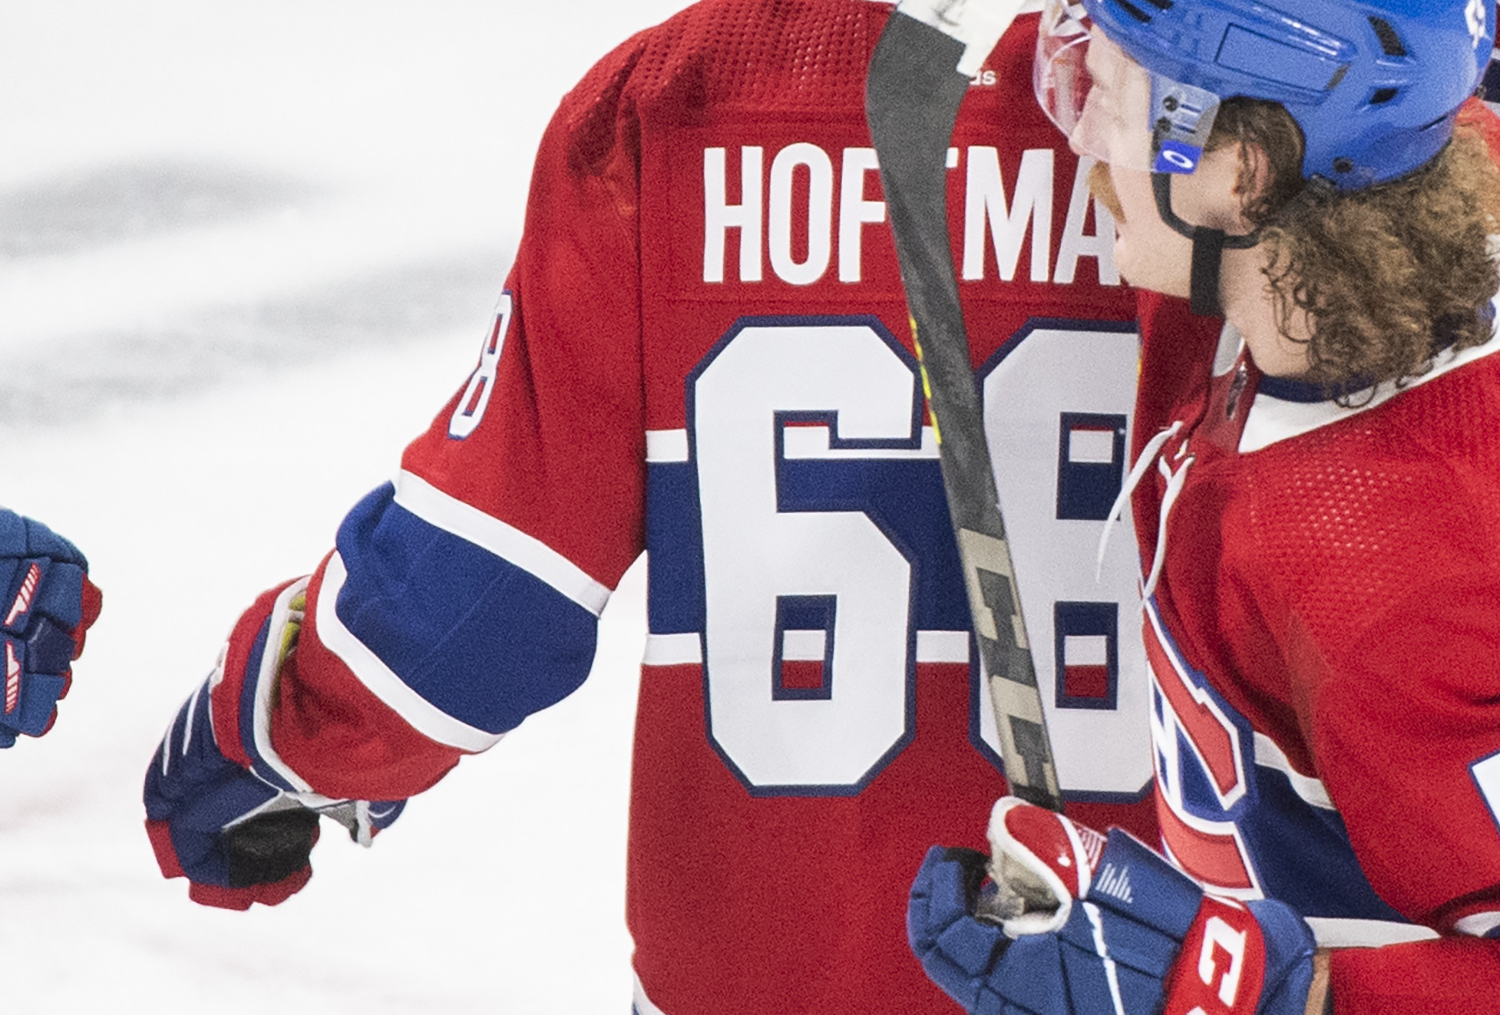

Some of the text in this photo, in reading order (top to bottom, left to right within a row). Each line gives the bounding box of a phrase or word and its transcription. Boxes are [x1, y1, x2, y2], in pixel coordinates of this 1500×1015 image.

[702, 141, 1122, 287] HOFMA
[446, 288, 513, 440] 8
[684, 313, 1158, 804] 68
